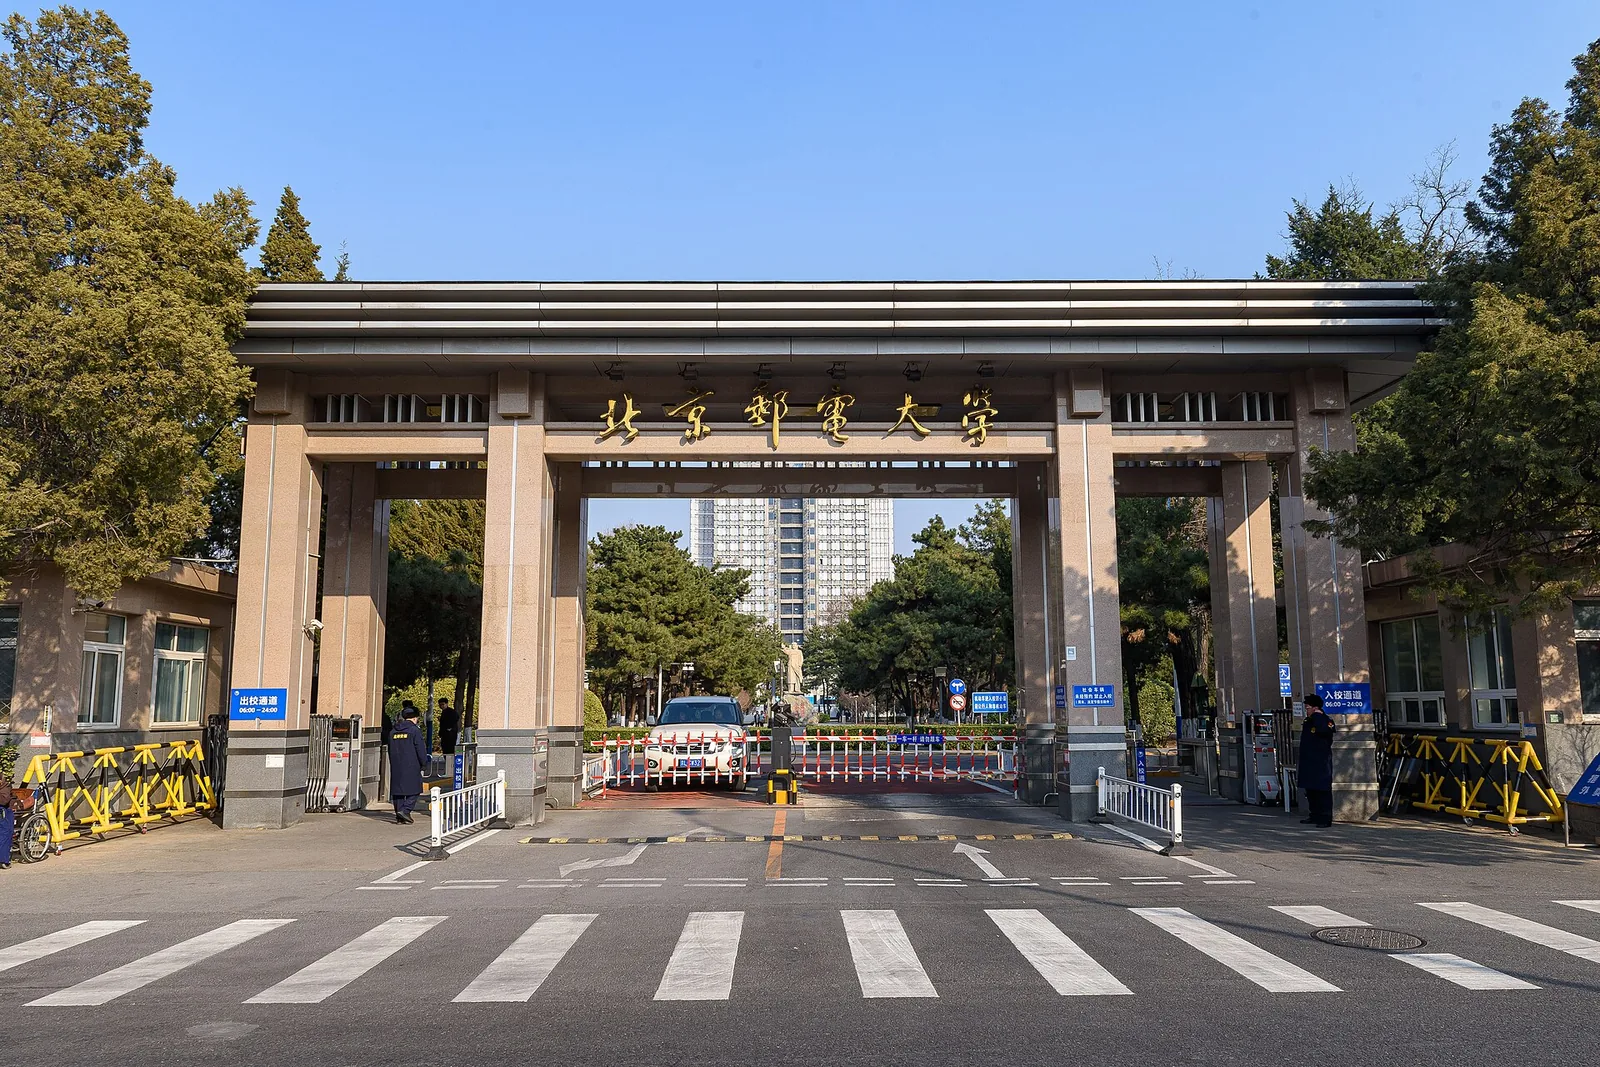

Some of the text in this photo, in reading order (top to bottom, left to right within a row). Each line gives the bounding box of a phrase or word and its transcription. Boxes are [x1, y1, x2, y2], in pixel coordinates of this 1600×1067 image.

[240, 695, 278, 705] 出校通道
[1324, 690, 1362, 700] 入校通道
